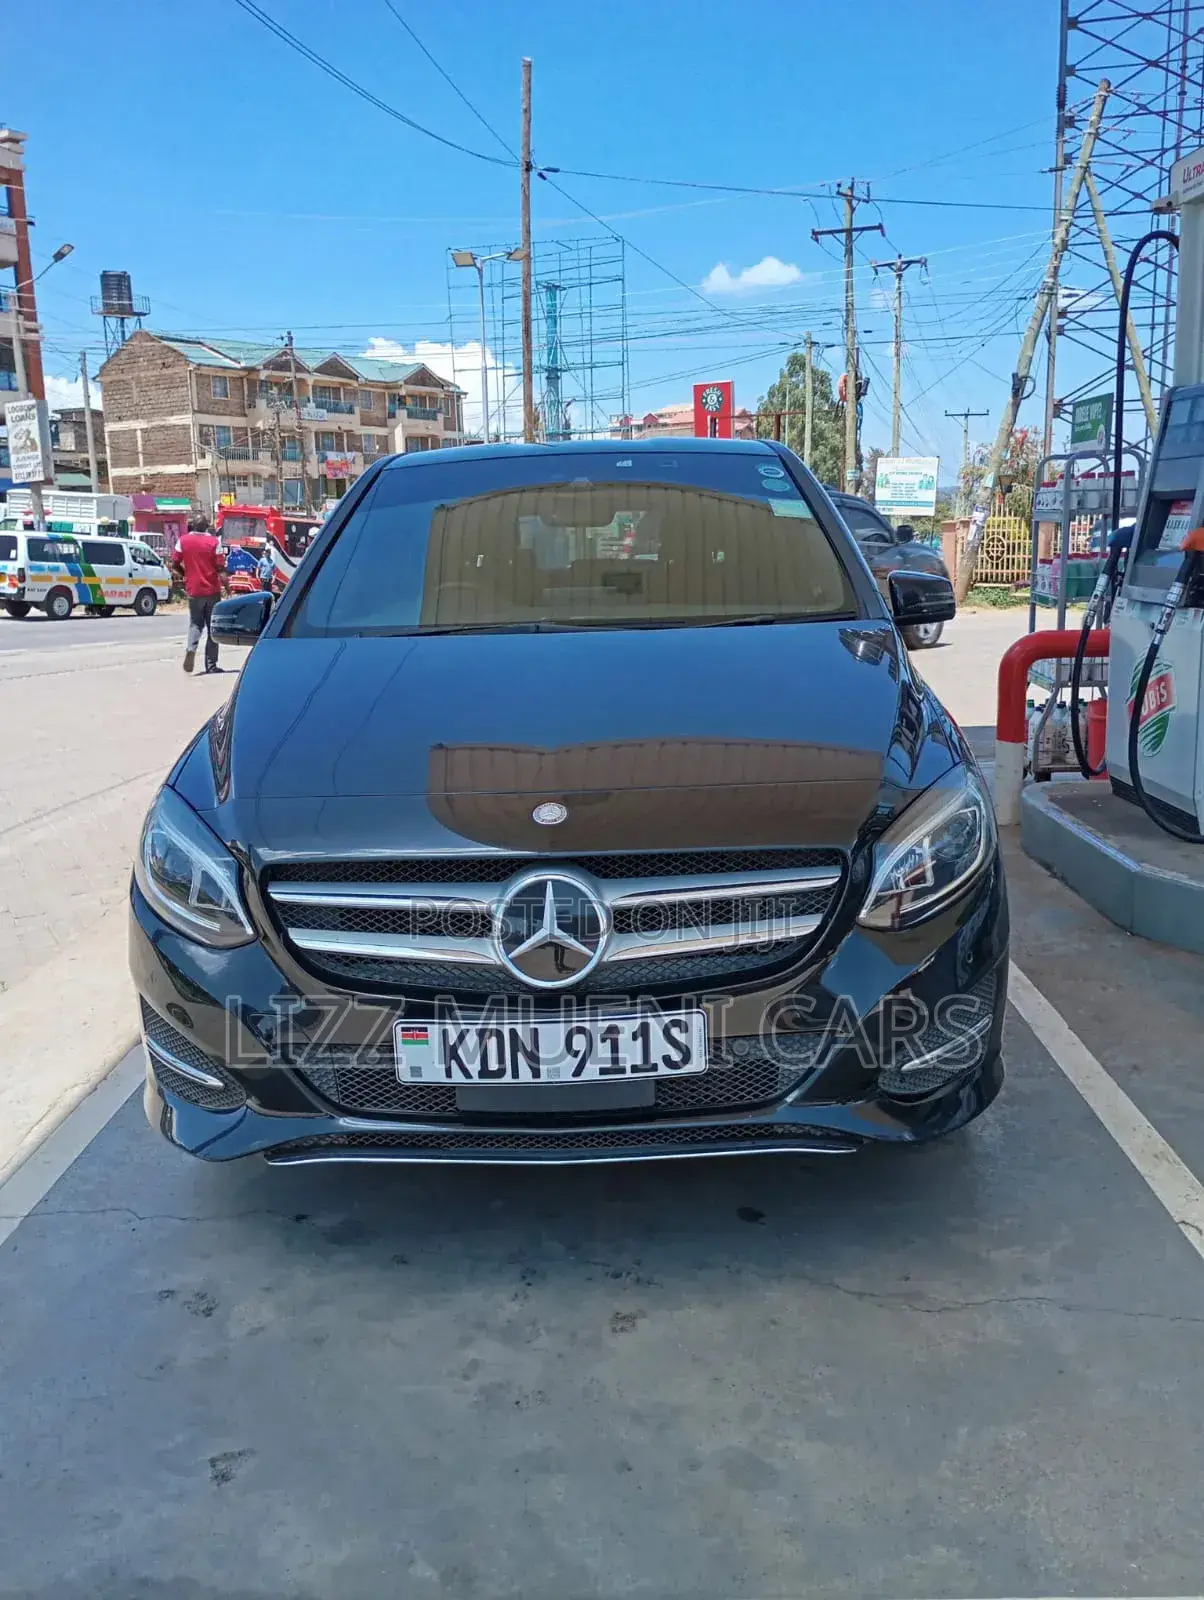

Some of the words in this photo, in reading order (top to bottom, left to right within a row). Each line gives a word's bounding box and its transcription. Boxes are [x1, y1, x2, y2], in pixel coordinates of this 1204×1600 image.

[11, 412, 36, 423] LOANS
[442, 1027, 542, 1079] KDN
[565, 1018, 692, 1078] 911S
